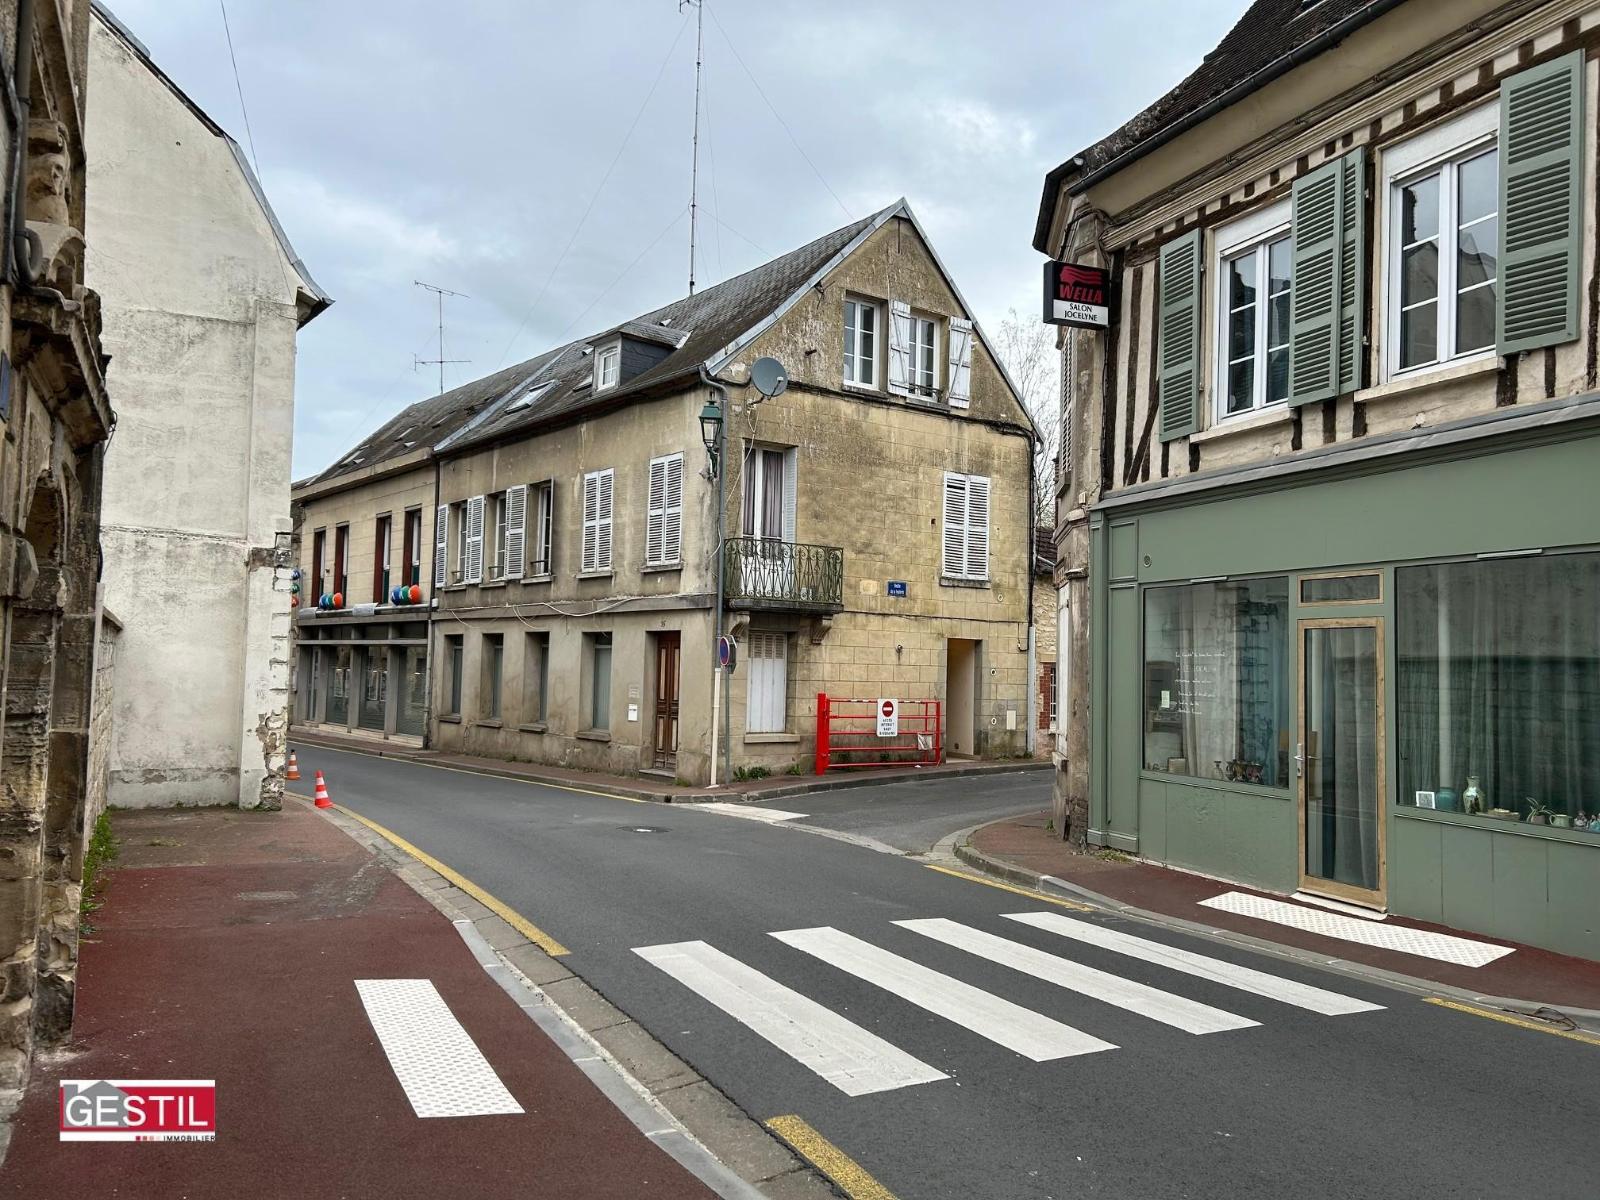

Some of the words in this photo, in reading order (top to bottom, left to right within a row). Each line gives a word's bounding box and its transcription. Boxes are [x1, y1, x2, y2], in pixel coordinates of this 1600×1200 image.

[1059, 284, 1103, 304] WELLA
[1069, 303, 1092, 312] SALON
[1064, 310, 1098, 321] JOCELYNE
